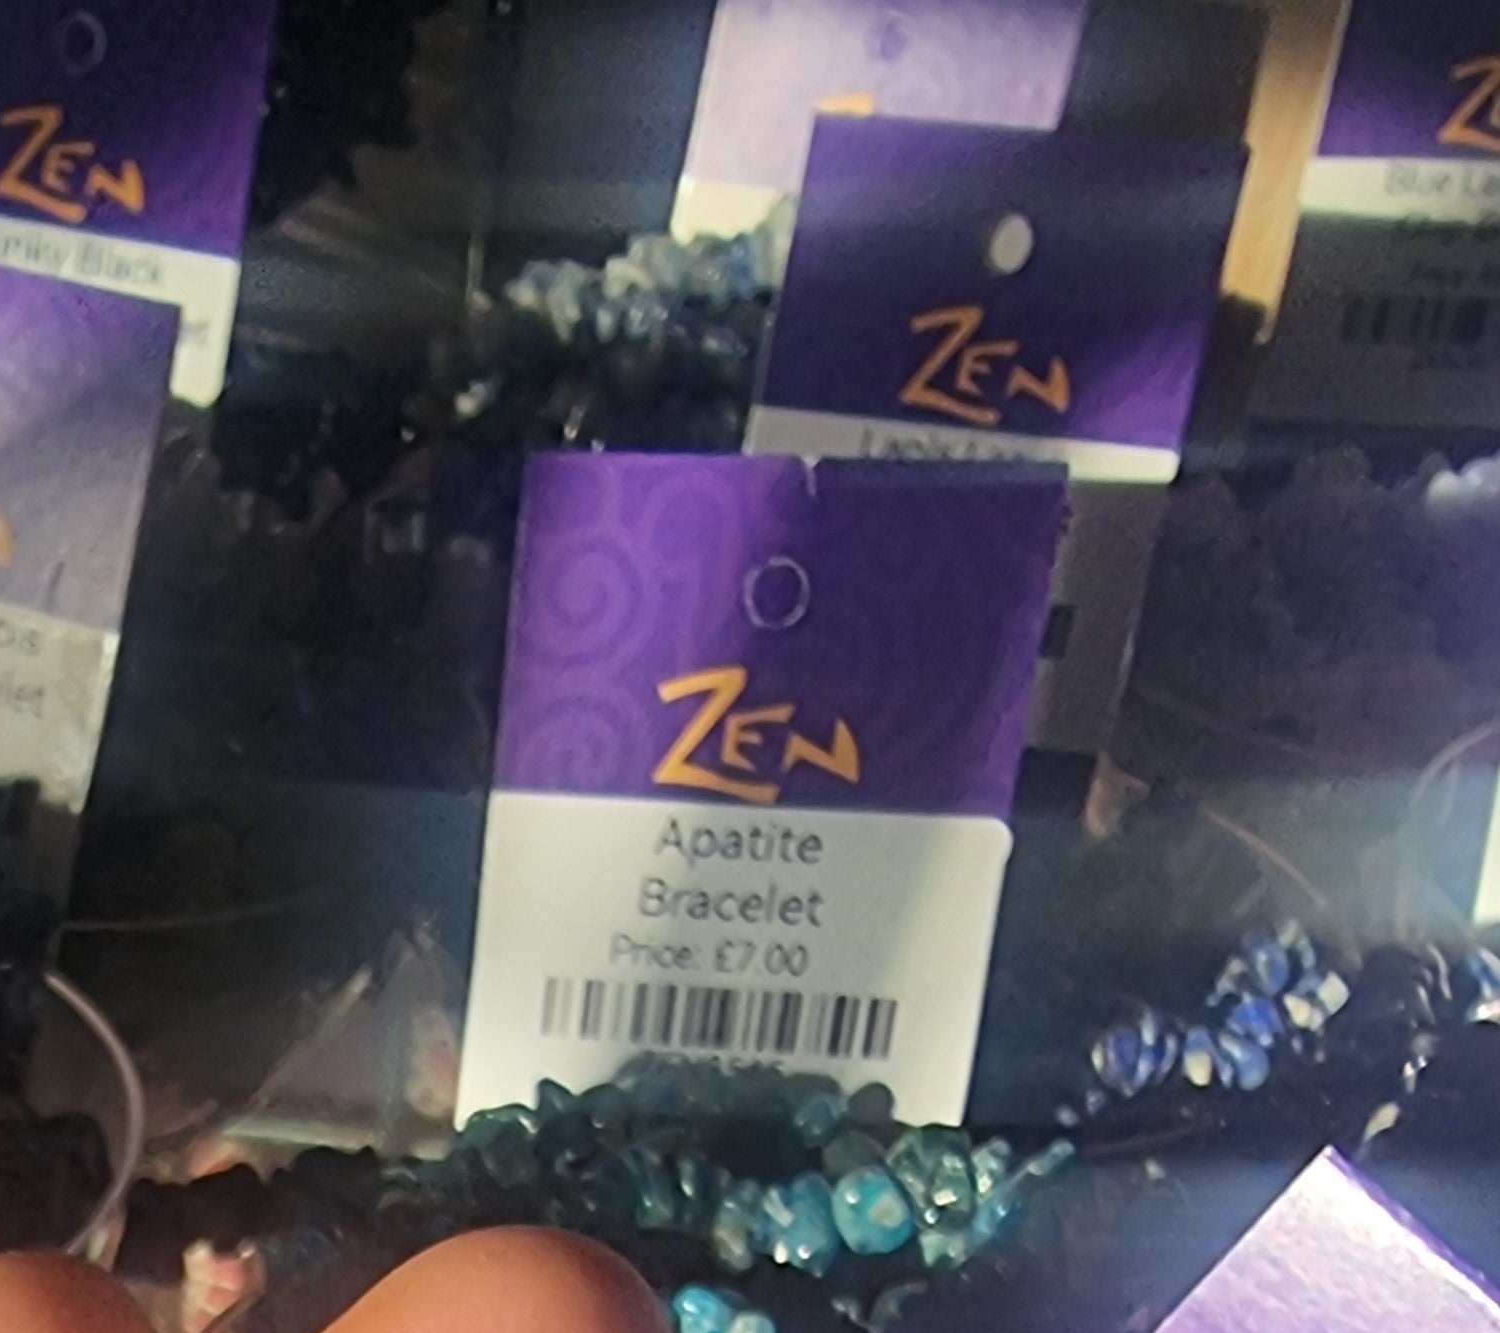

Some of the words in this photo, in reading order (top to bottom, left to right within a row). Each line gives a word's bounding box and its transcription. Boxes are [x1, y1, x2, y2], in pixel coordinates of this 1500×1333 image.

[899, 305, 1071, 427] ZEN
[652, 664, 860, 805] ZEN
[653, 817, 824, 869] Apatite
[637, 876, 824, 928] Bracelet
[609, 933, 701, 972] Price:
[714, 938, 810, 977] £7.00
